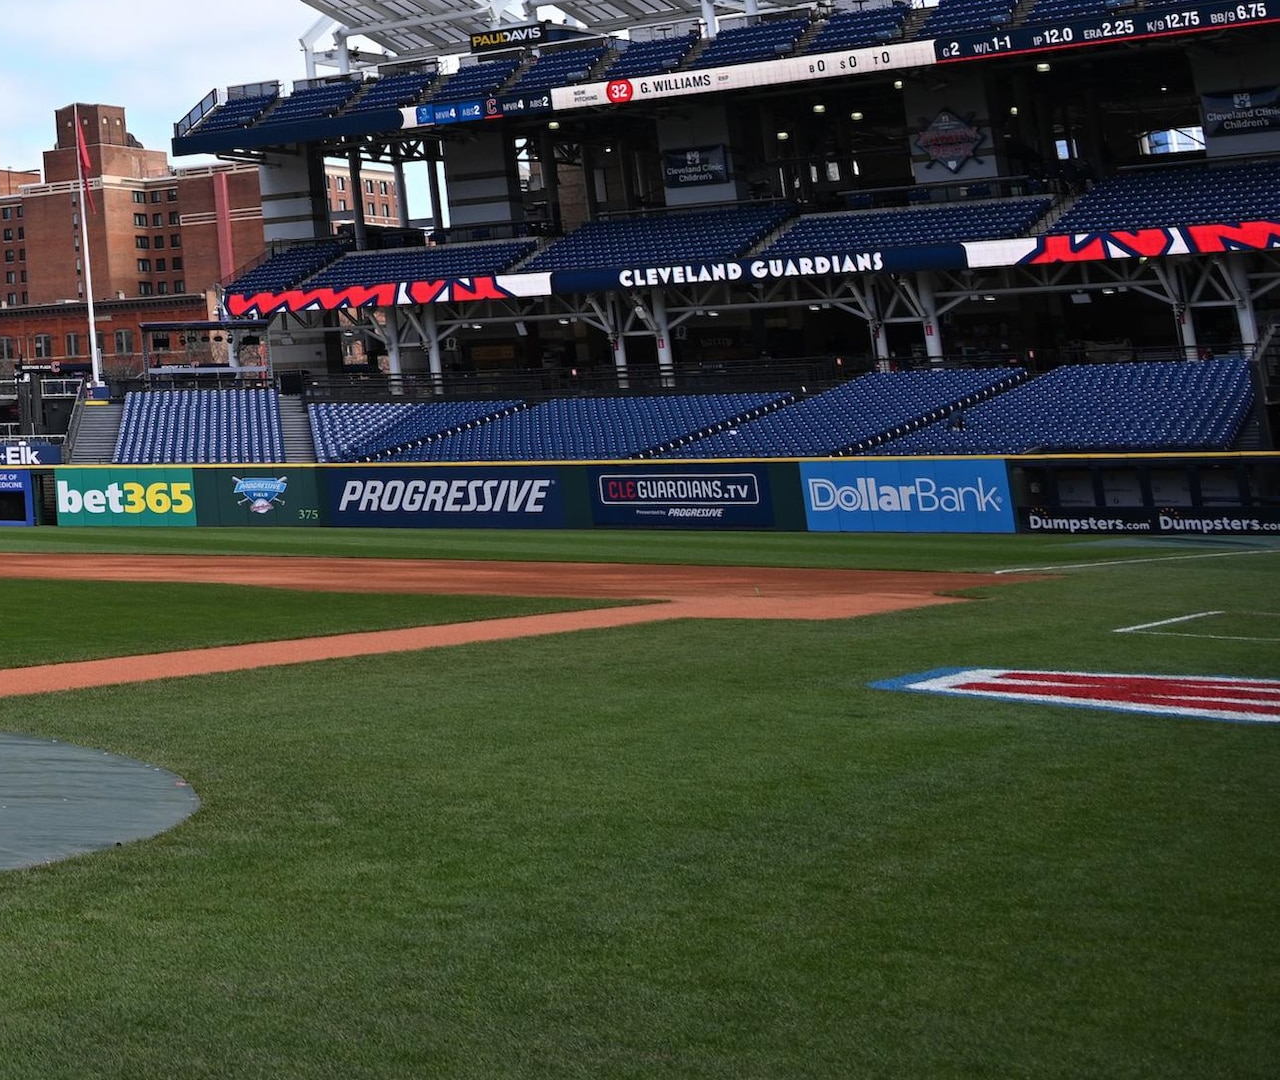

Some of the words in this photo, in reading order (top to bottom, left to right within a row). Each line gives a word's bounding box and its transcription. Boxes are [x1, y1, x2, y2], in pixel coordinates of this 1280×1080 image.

[943, 47, 949, 57] G
[951, 42, 960, 55] 2
[974, 43, 992, 54] W/L
[992, 36, 1012, 50] 1-1
[1033, 37, 1042, 46] IP
[1044, 28, 1073, 43] 12.0
[1084, 29, 1102, 39] ERA
[1102, 20, 1134, 36] 2.25
[1147, 21, 1164, 32] K/9
[1165, 12, 1200, 28] 12.75
[1211, 13, 1235, 24] BB/9
[1237, 3, 1267, 19] 6.75
[611, 85, 627, 98] 32
[640, 83, 652, 93] G.
[654, 75, 711, 92] WILLIAMS
[667, 161, 701, 175] Cleveland
[703, 162, 724, 172] Clinic
[679, 173, 713, 182] Children's
[619, 262, 742, 287] CLEVELAND
[750, 252, 884, 278] GUARDIANS
[56, 480, 193, 514] bet365
[339, 479, 551, 513] PROGRESSIVE
[811, 477, 1002, 513] DollarBank
[299, 510, 318, 519] 375
[1029, 514, 1150, 532] Dumpsters.com
